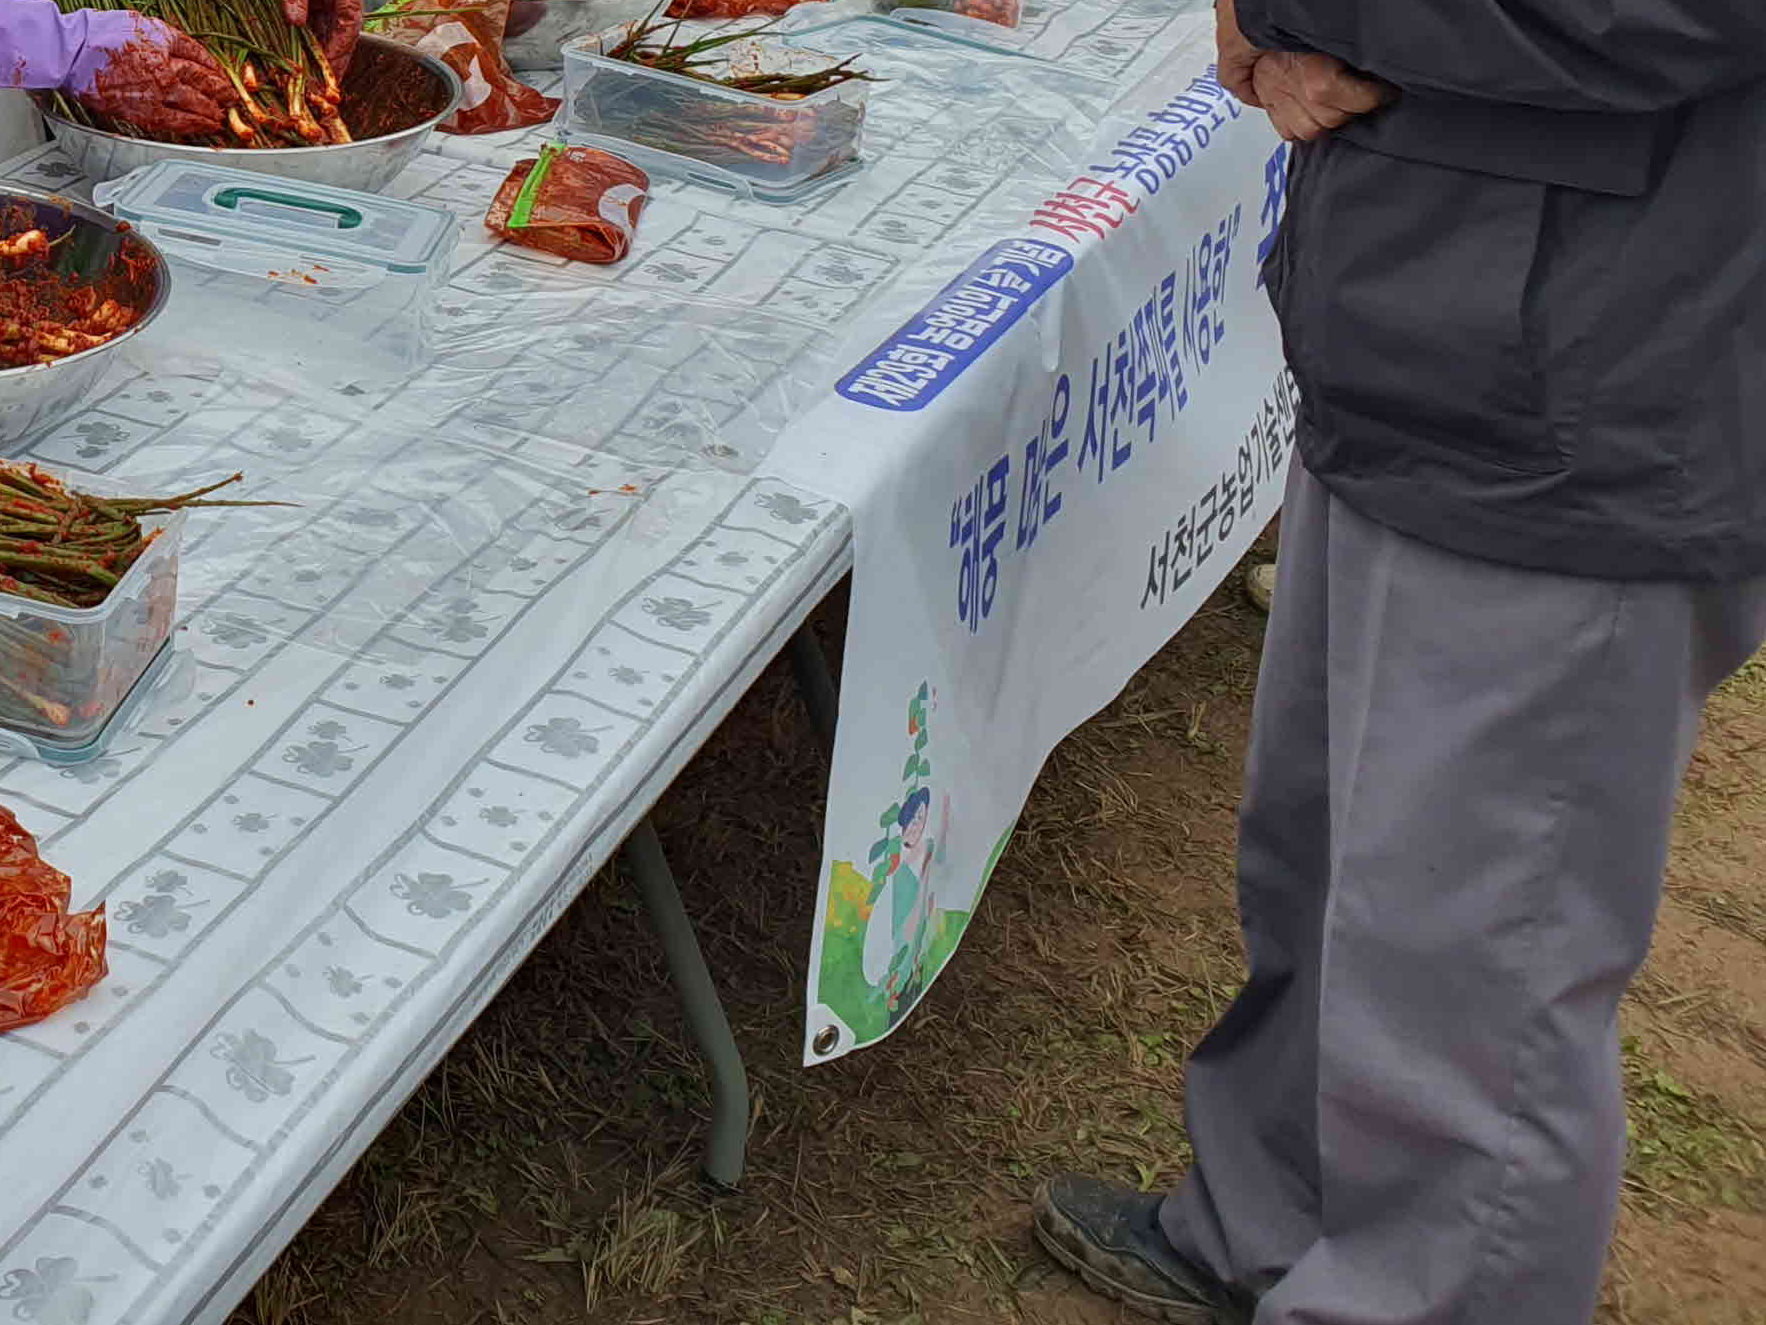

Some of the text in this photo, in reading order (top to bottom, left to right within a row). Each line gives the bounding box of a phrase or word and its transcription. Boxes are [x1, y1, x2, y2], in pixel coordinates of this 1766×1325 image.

[846, 343, 955, 408] 제29회
[906, 283, 1019, 351] 농업인의
[1028, 176, 1141, 245] 서천군
[1146, 95, 1227, 150] 홍보
